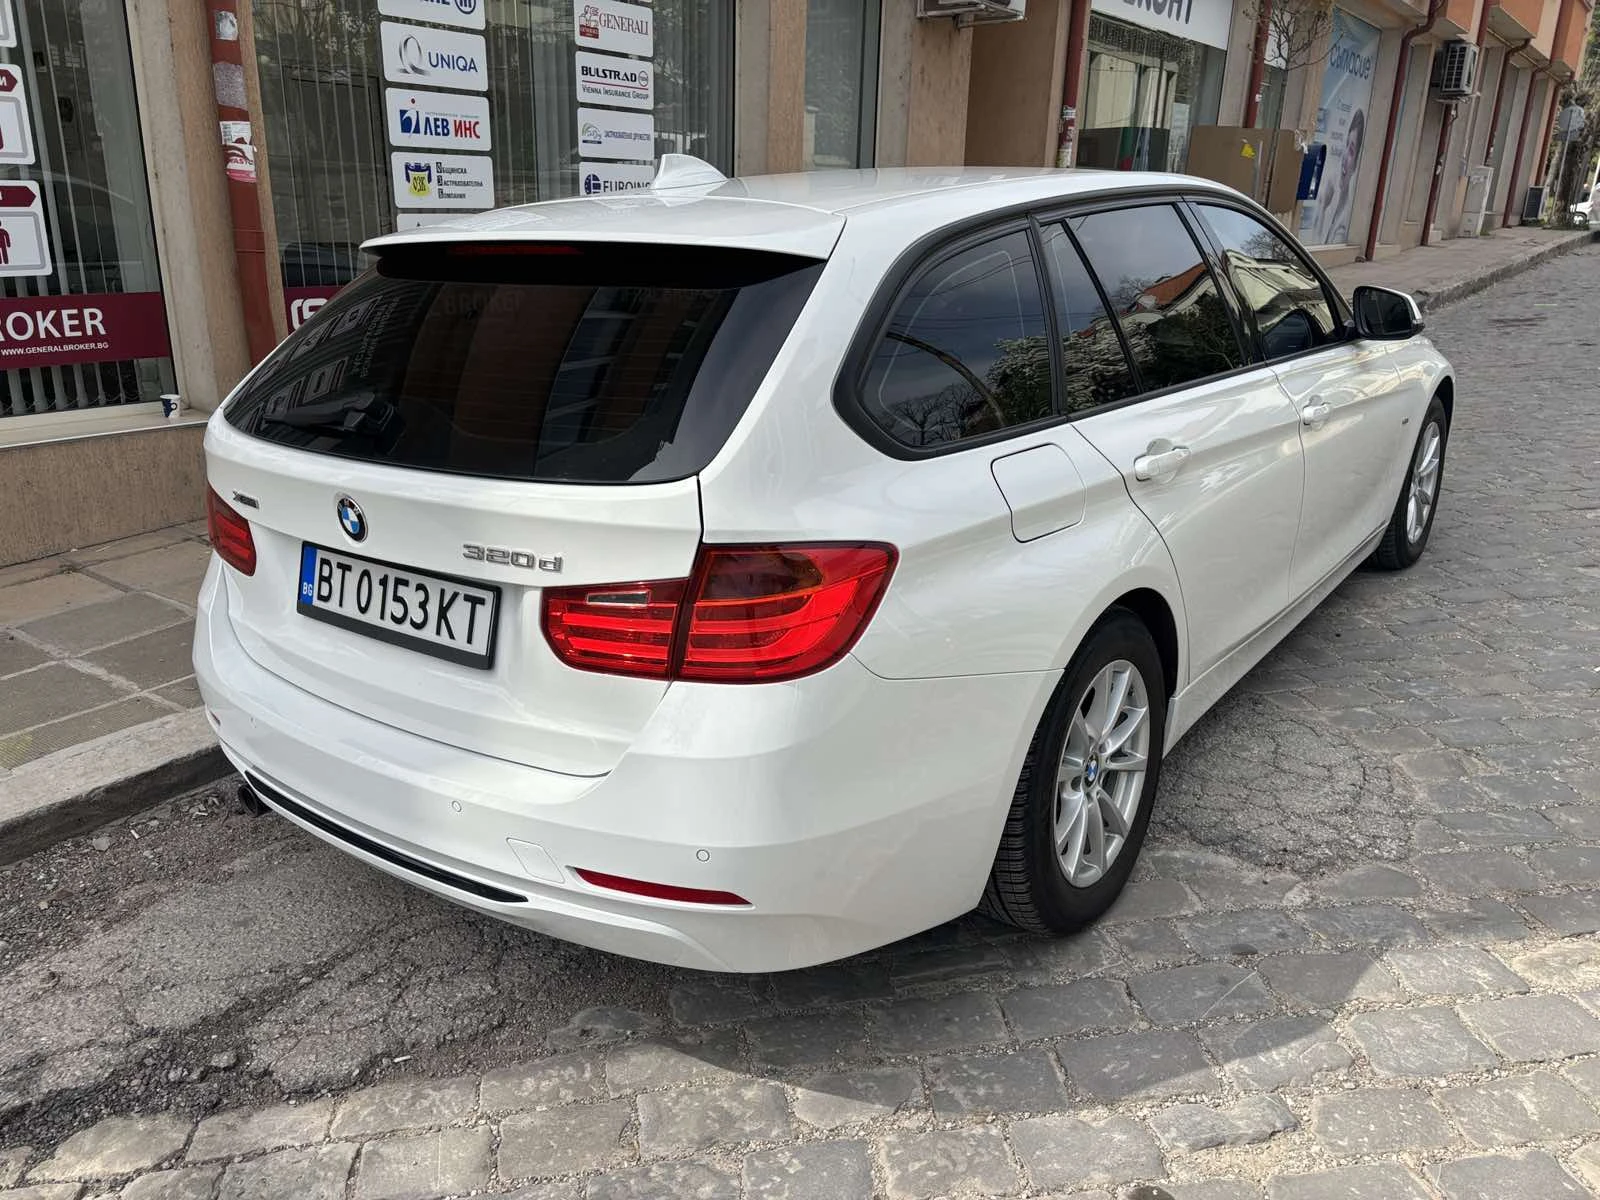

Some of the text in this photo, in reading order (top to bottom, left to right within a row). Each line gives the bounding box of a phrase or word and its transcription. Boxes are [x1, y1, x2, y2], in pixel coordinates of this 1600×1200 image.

[599, 12, 649, 36] GENERALI
[428, 51, 478, 73] UNIQA
[581, 65, 637, 83] BULSTRAD
[424, 116, 481, 139] ЛЕВ ИНС
[0, 307, 107, 342] OKER
[1, 341, 109, 357] WWW.GENERALBROKER.BG
[303, 581, 313, 597] BG
